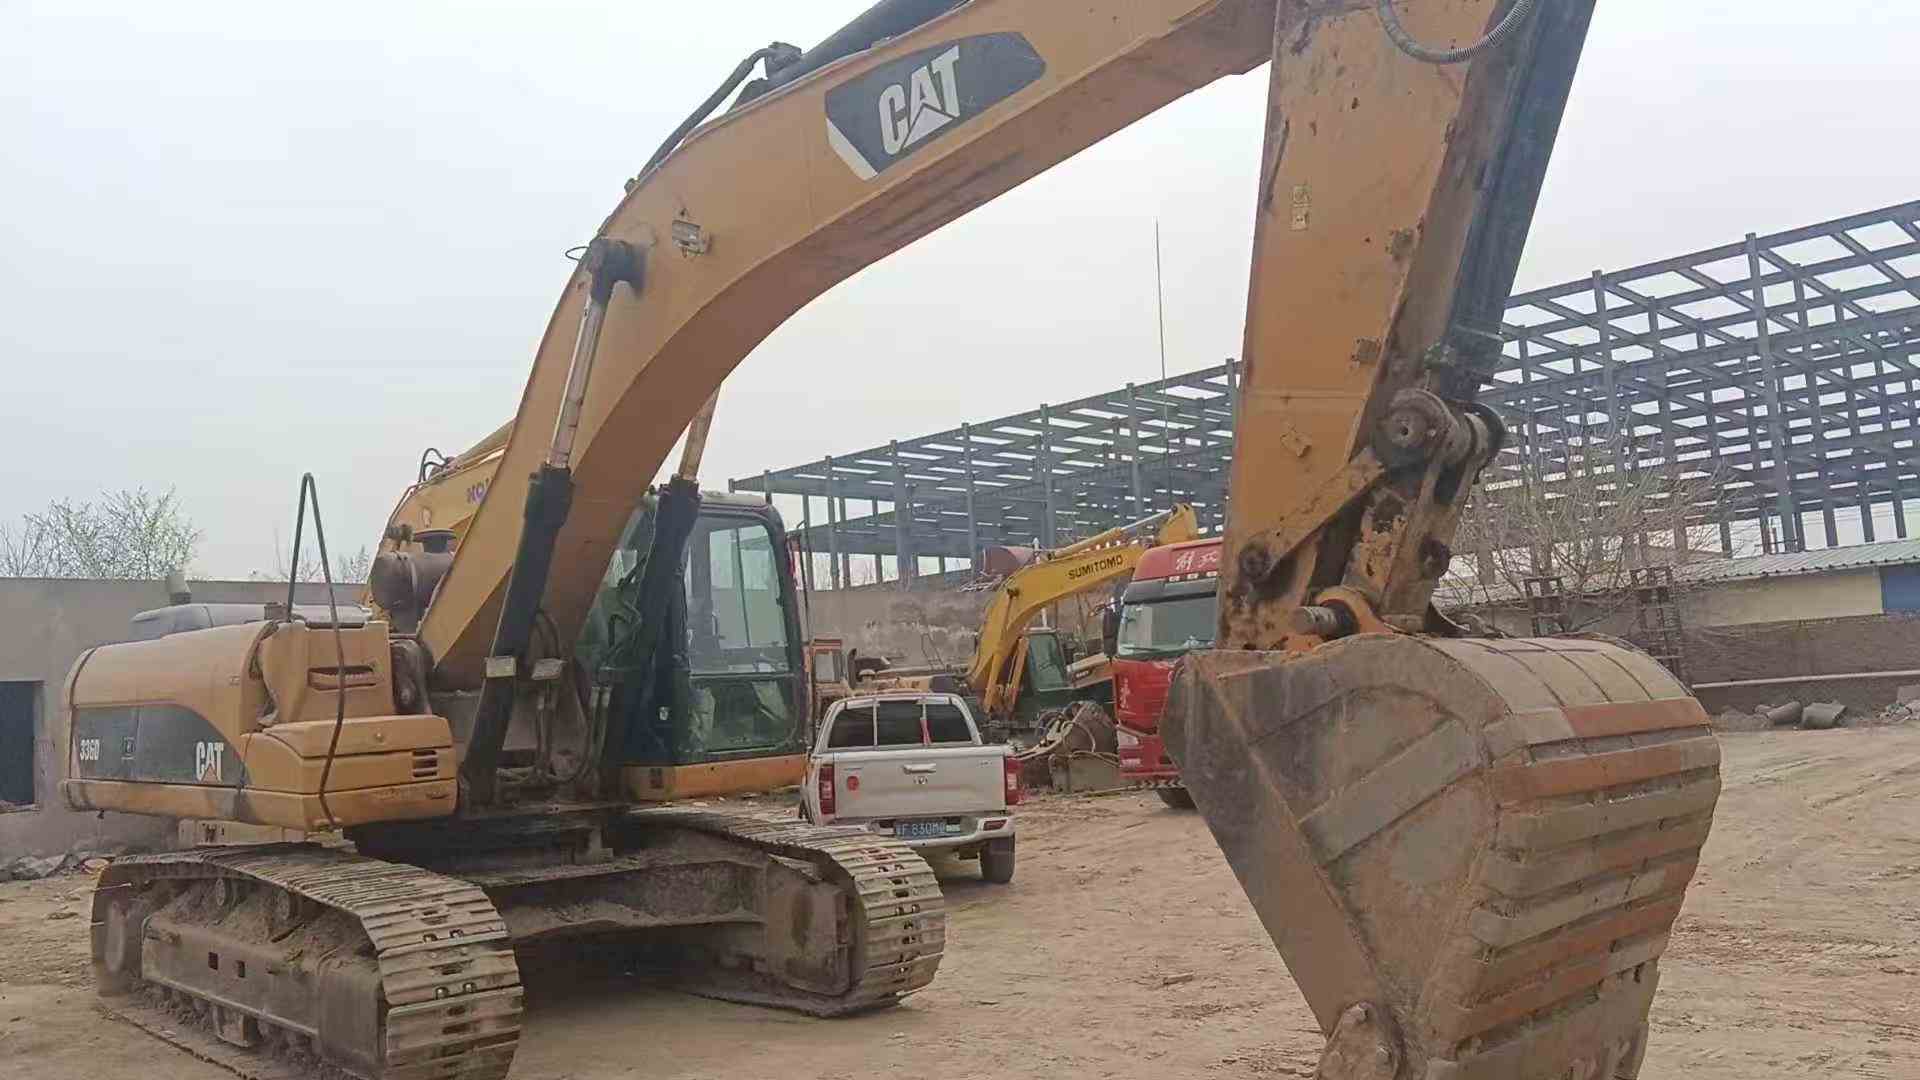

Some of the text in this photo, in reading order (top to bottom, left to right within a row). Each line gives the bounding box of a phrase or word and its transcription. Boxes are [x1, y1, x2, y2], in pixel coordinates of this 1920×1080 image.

[879, 45, 961, 155] CAT
[1068, 554, 1124, 580] SUMITOMO
[79, 738, 100, 761] 336D
[195, 741, 225, 783] CAT
